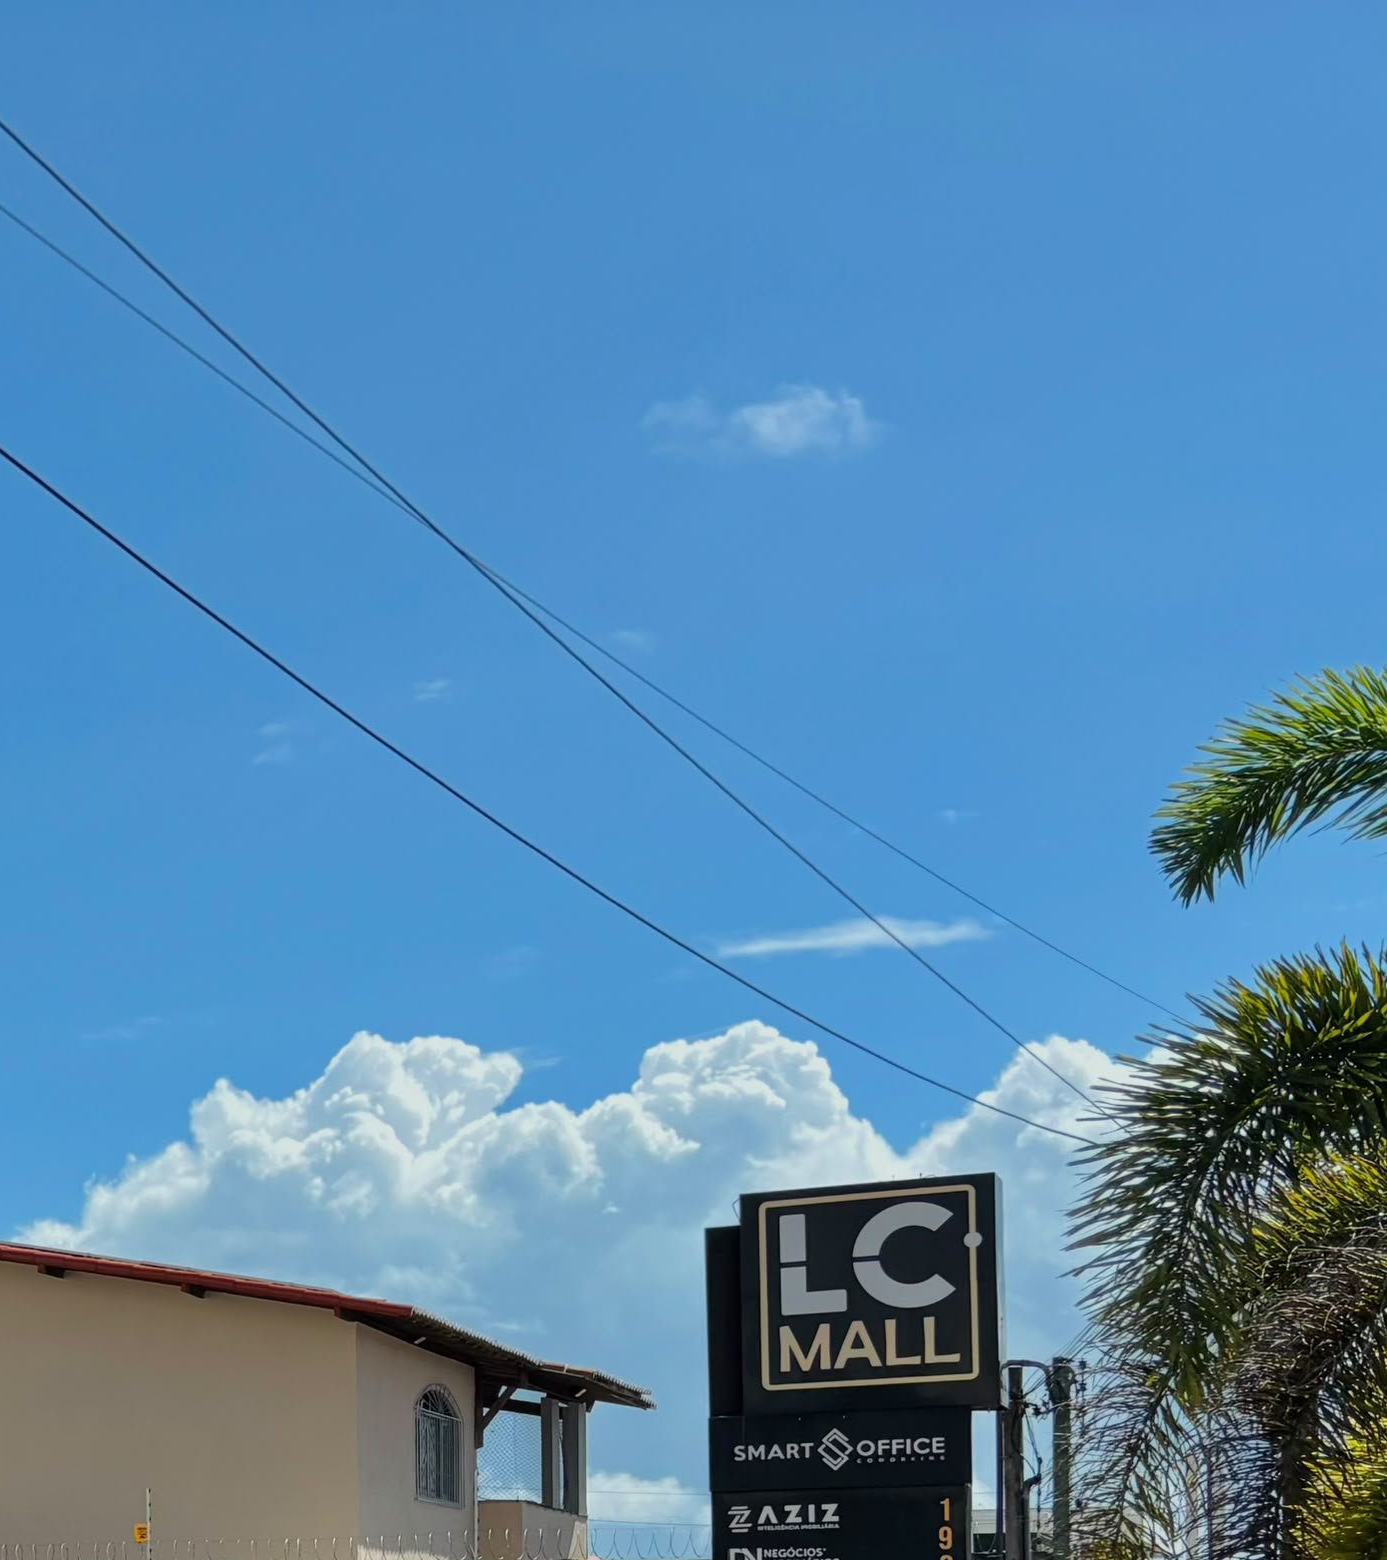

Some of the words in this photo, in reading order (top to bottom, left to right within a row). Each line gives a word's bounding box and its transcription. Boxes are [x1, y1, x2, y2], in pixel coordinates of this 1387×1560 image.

[779, 1201, 957, 1316] LC
[779, 1316, 962, 1373] MALL
[733, 1442, 815, 1462] SMART
[856, 1437, 946, 1457] OFFICE
[756, 1503, 840, 1524] AZIZ
[763, 1547, 824, 1558] NEGÓCIOS
